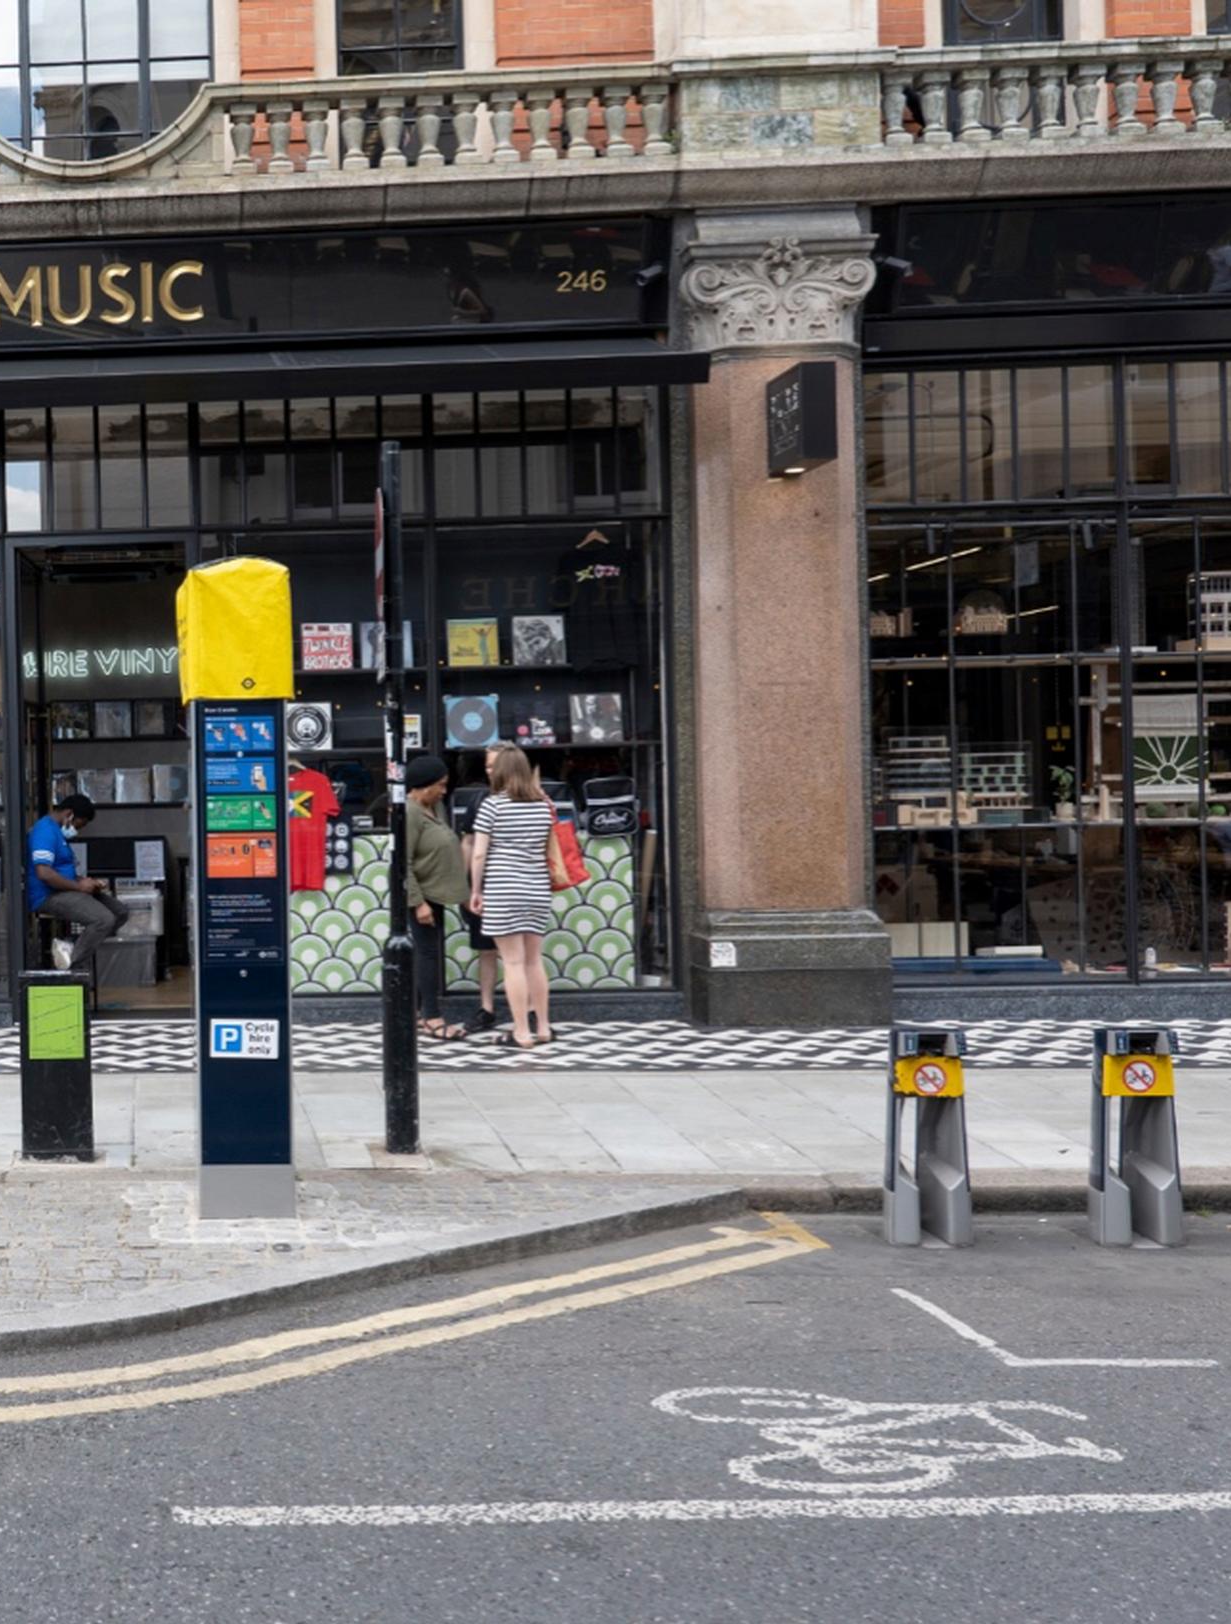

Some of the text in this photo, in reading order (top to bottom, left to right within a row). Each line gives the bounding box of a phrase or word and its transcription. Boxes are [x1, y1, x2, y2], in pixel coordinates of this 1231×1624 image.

[555, 269, 607, 293] 246
[93, 646, 178, 676] VINY
[220, 1022, 275, 1050] P Cycle
[249, 1033, 271, 1043] hire
[249, 1045, 271, 1055] only
